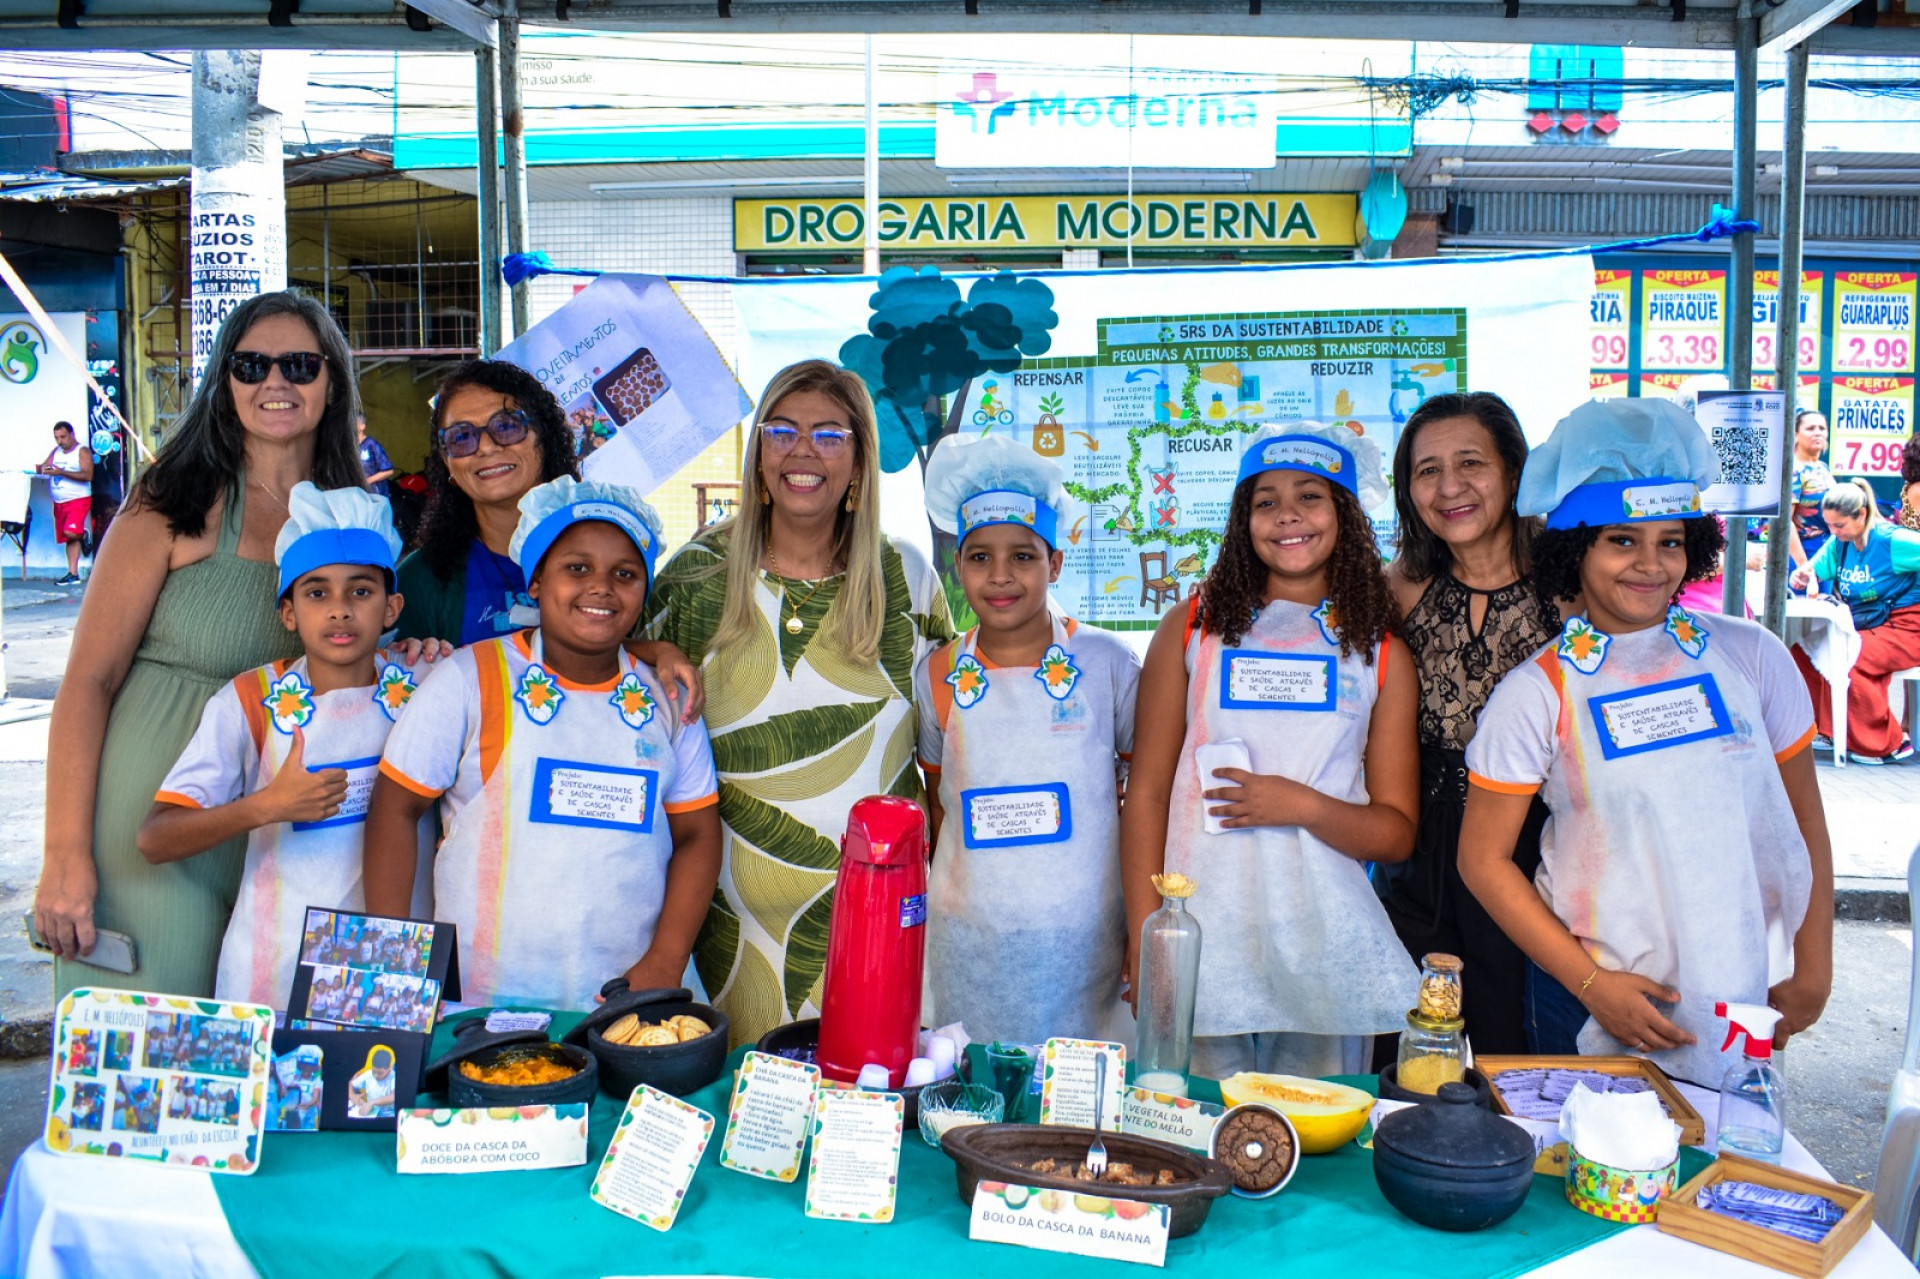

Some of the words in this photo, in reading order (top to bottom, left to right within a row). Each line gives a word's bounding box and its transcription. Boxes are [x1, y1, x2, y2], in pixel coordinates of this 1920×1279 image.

[540, 77, 558, 85] sua
[560, 72, 595, 85] saúde.
[1028, 89, 1257, 128] Moderna
[765, 202, 1026, 243] DROGARIA
[1057, 200, 1317, 240] MODERNA
[192, 251, 248, 265] AROT
[209, 270, 252, 280] PESSOA
[1656, 271, 1710, 281] OFERTA
[1848, 273, 1901, 284] OFERTA
[221, 283, 227, 293] 7
[230, 282, 257, 293] DIAS
[1653, 293, 1685, 301] BISCOITO
[1687, 293, 1717, 301] MAIZENA
[1845, 294, 1907, 303] REFRIGERANTE
[1649, 301, 1719, 321] PIRAQUE
[1841, 304, 1909, 325] GUARAPLUS
[1180, 324, 1207, 338] 5RS
[1212, 324, 1233, 337] DA
[1240, 319, 1384, 337] SUSTENTABILIDADE
[1112, 348, 1178, 363] PEQUENAS
[1183, 346, 1252, 361] ATITUDES,
[1257, 344, 1316, 358] GRANDES
[1321, 338, 1446, 359] TRANSFORMAÇÕES!
[1658, 334, 1718, 365] 3,39
[1849, 337, 1908, 368] 2,99
[1311, 361, 1374, 376] REDUZIR
[554, 374, 565, 385] DE
[1013, 371, 1084, 386] REPENSAR
[1845, 377, 1899, 389] OFERTA
[1843, 400, 1900, 408] BATATA
[1837, 408, 1905, 431] PRINGLES
[1168, 438, 1233, 454] RECUSAR
[1845, 442, 1903, 472] 7,99
[1240, 668, 1312, 677] SUSTENTABILIDADE
[1280, 677, 1313, 685] ATRAVÉS
[1617, 698, 1694, 720] SUSTENTABILIDADE
[1663, 707, 1699, 719] ATRAVÉS
[1650, 720, 1680, 731] CASCAS
[1646, 727, 1687, 741] SEMENTES
[560, 780, 633, 795] SUSTENTABILIDADE
[584, 801, 611, 809] CASCAS
[600, 795, 633, 804] ATRAVÉS
[977, 801, 1045, 812] SUSTENTABILIDADE
[1014, 808, 1047, 817] ATRAVÉS
[577, 810, 616, 819] SEMENTES
[996, 827, 1032, 835] SEMENTES
[1129, 1104, 1168, 1121] VEGETAL
[1171, 1113, 1183, 1124] DA
[1144, 1118, 1157, 1129] DO
[1159, 1121, 1193, 1137] MELÃO
[181, 1129, 198, 1145] CHÃO
[202, 1131, 211, 1143] DA
[421, 1143, 452, 1153] DOCE
[455, 1142, 471, 1152] DA
[474, 1141, 509, 1151] CASCA
[512, 1140, 527, 1150] DA
[420, 1153, 478, 1165] ABÓBORA
[481, 1153, 506, 1163] COM
[509, 1152, 540, 1162] COCO
[982, 1210, 1015, 1224] BOLO
[1018, 1217, 1034, 1228] DA
[1037, 1219, 1074, 1234] CASCA
[1078, 1225, 1094, 1237] DA
[1100, 1228, 1152, 1245] BANANA
